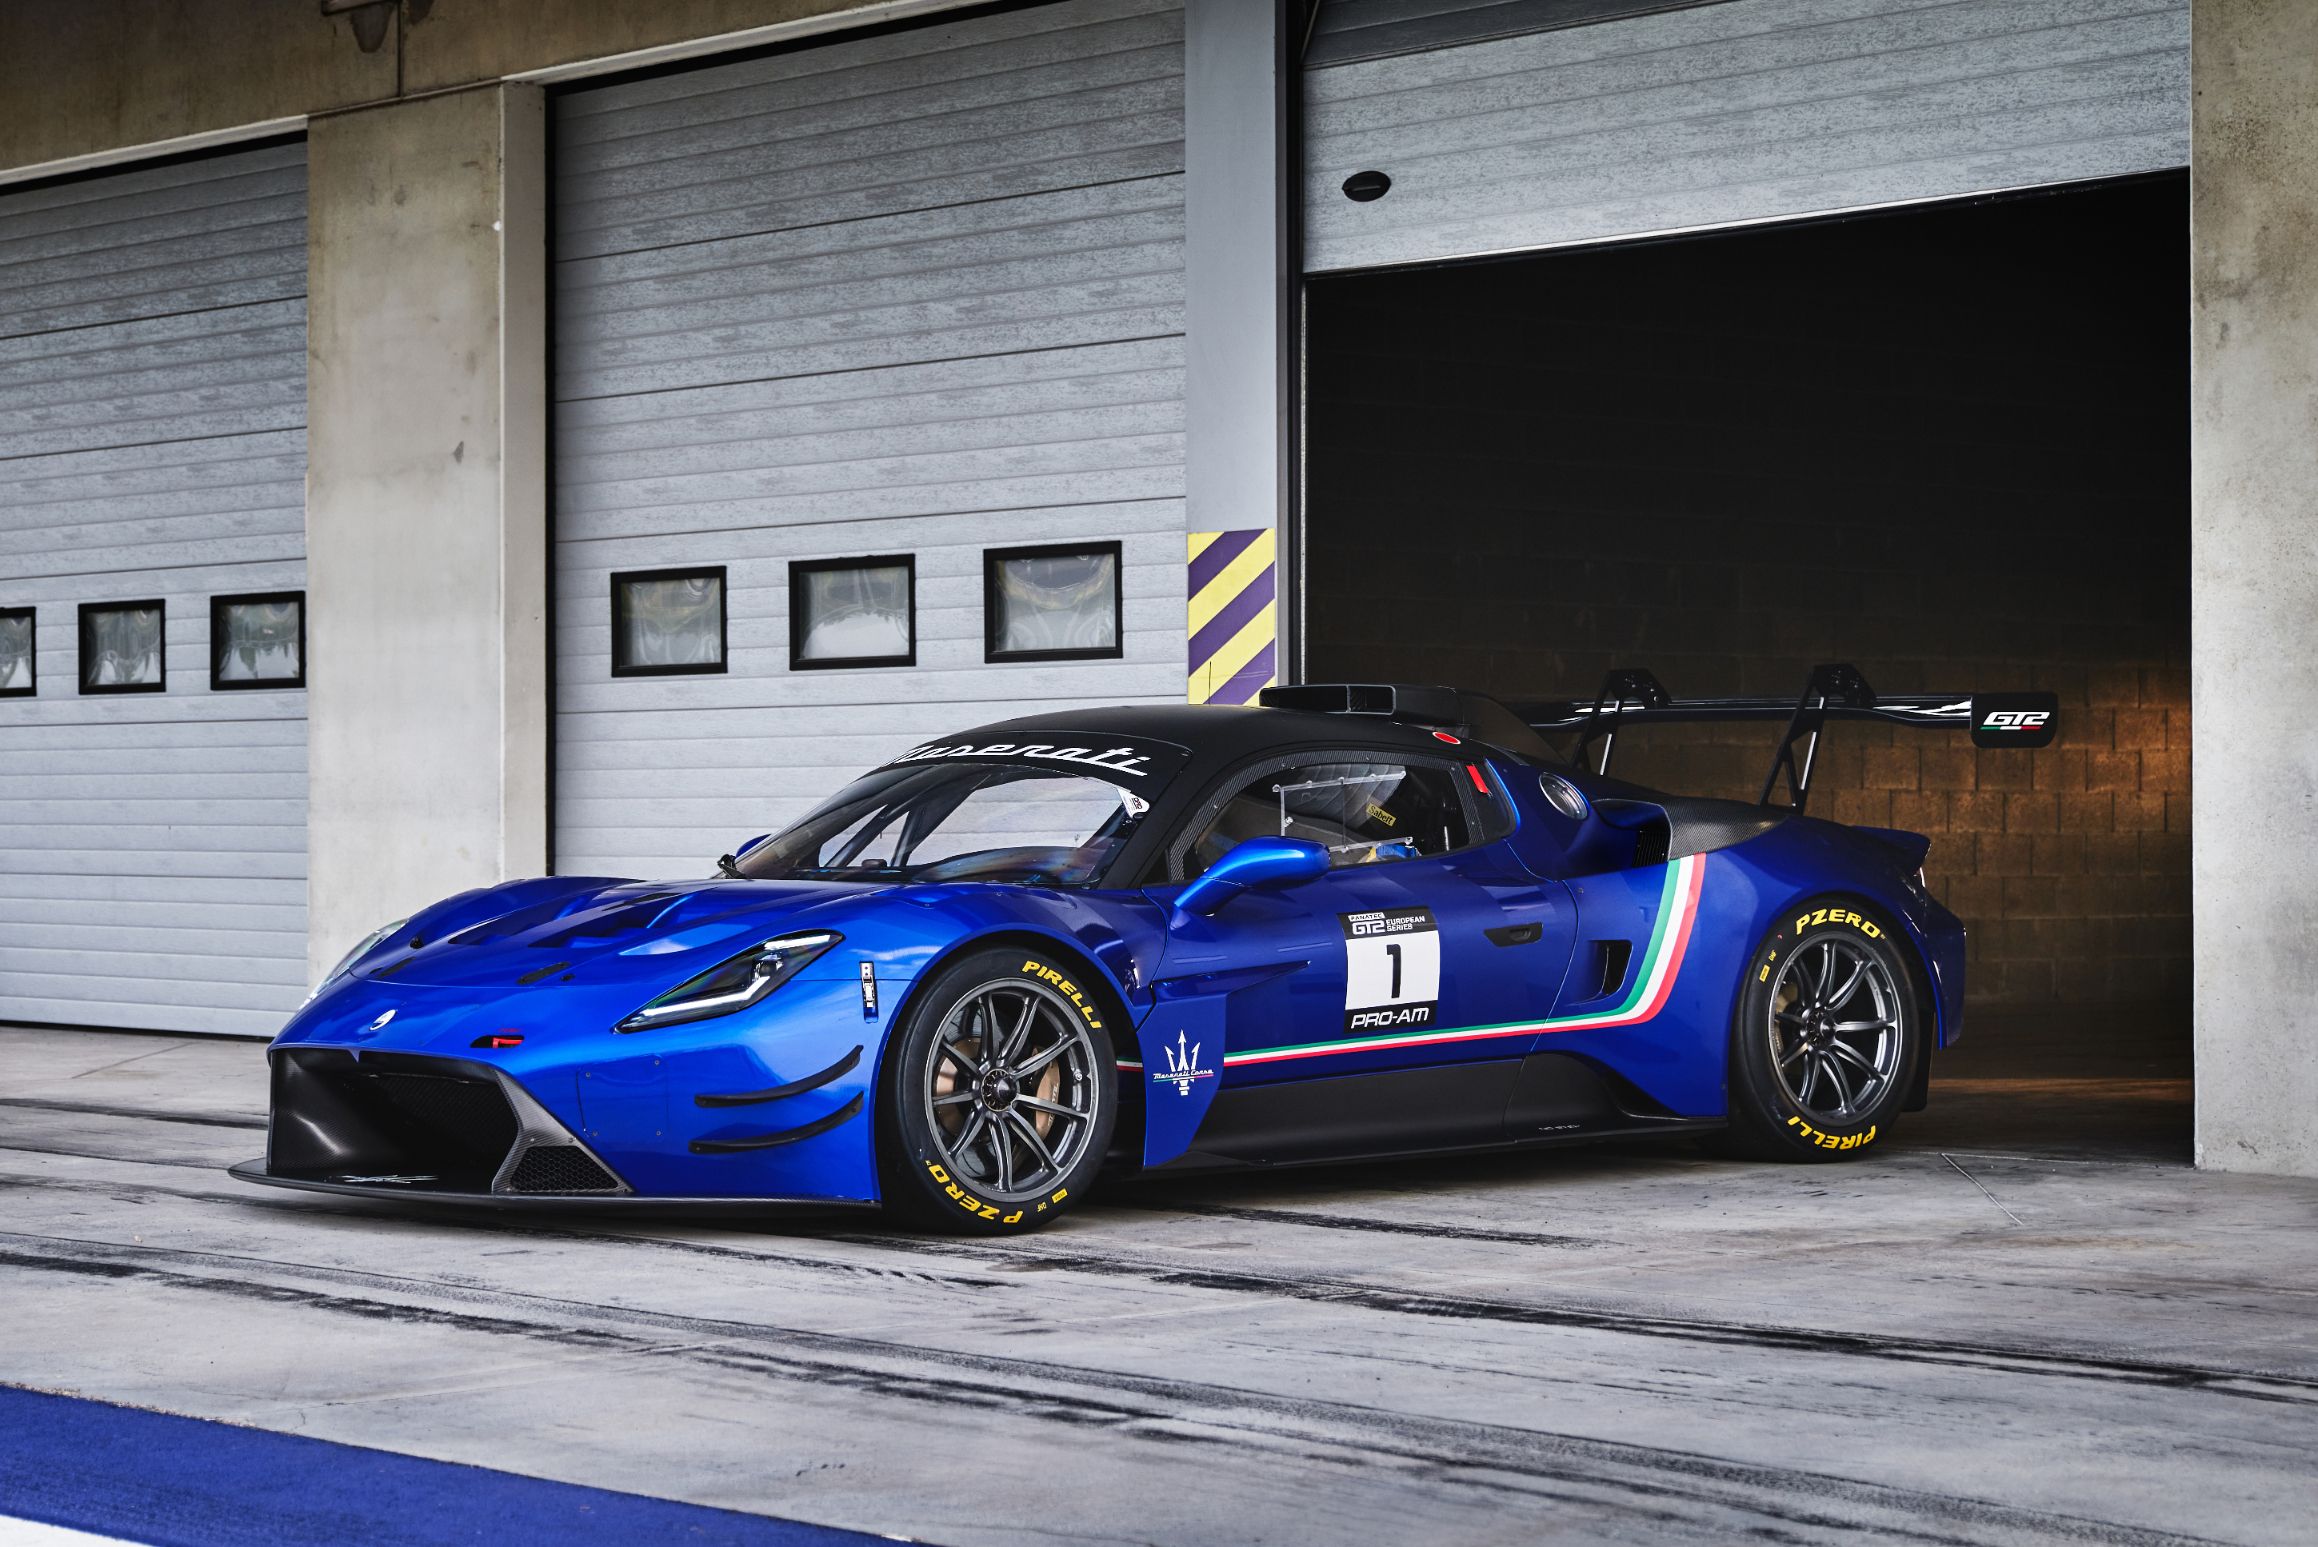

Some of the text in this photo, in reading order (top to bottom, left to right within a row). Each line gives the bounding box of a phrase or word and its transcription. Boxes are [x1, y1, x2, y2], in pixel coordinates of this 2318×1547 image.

[1983, 711, 2051, 726] GT2
[883, 744, 1151, 776] Maserati
[1369, 805, 1393, 825] Sabelt
[1352, 920, 1386, 935] GT2
[1386, 915, 1426, 926] EUROPEAN
[1386, 923, 1413, 932] SERIES
[1386, 943, 1402, 999] 1
[1022, 960, 1102, 1029] PIRELLI
[1350, 1007, 1430, 1029] PRO-AM
[1152, 1071, 1190, 1080] Maserati
[1787, 1116, 1876, 1150] PIRELLI
